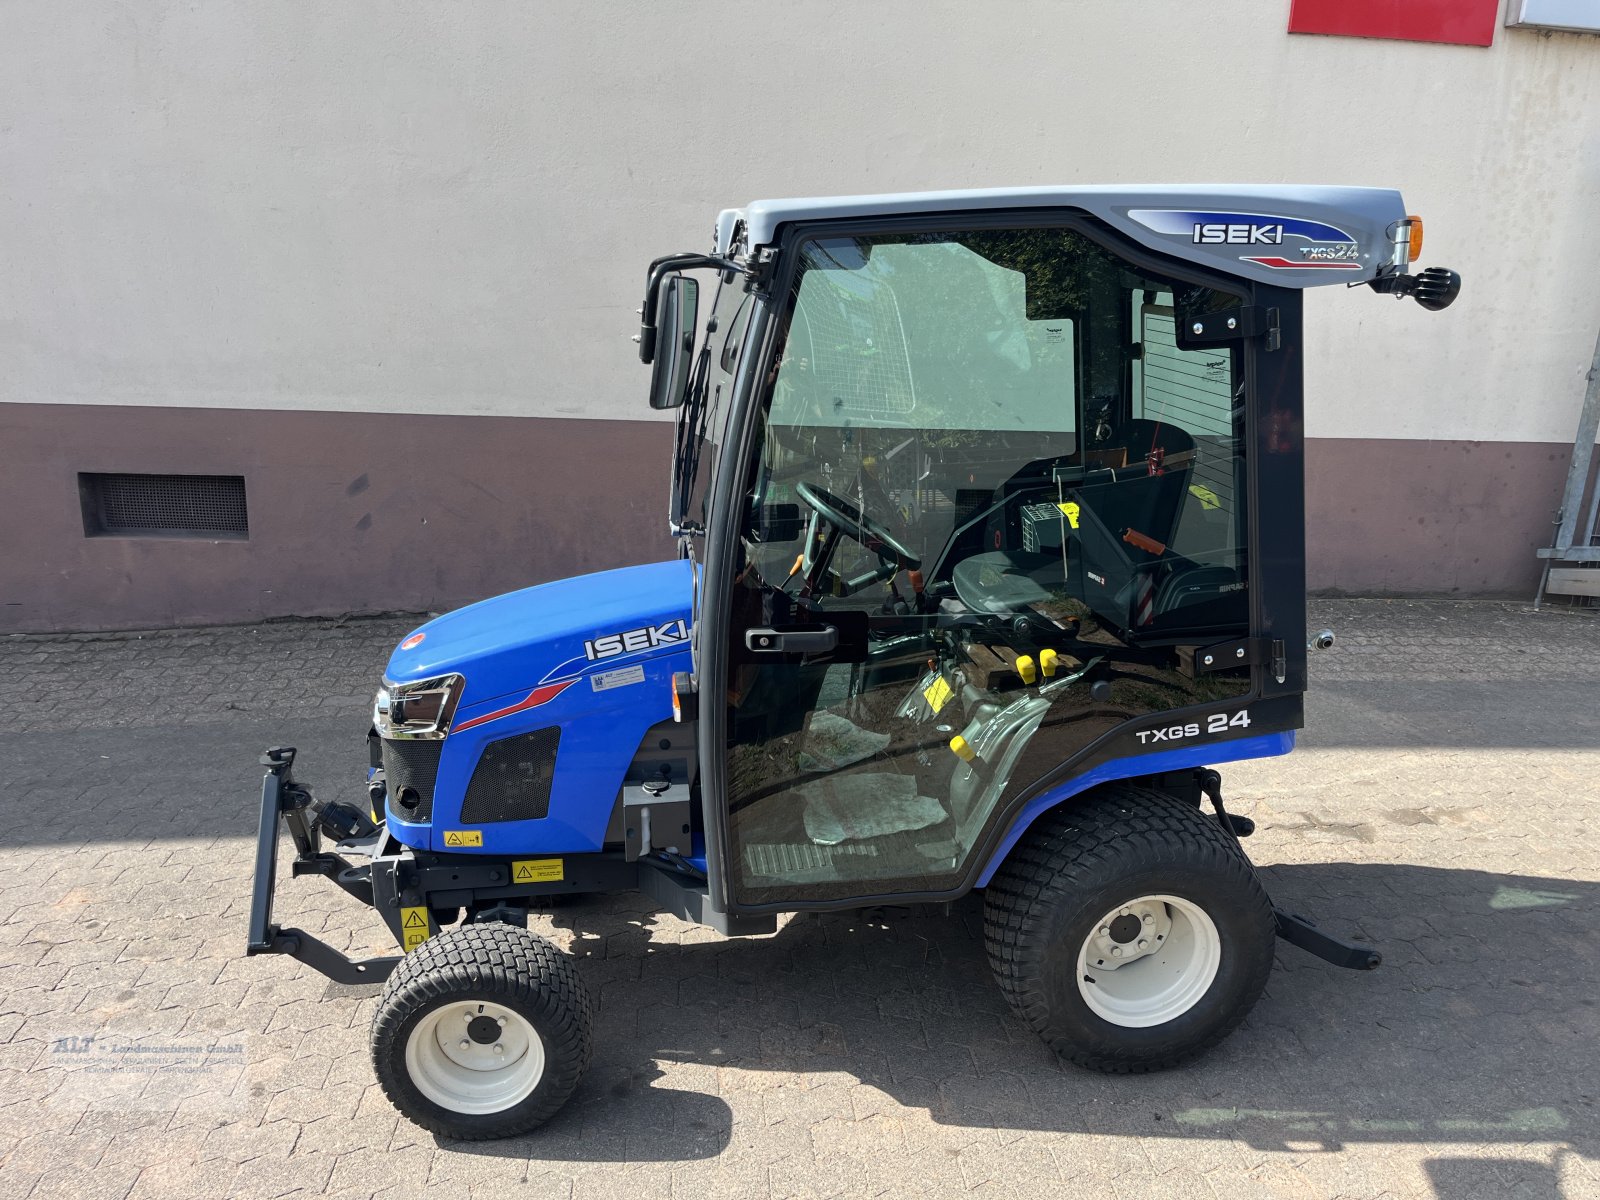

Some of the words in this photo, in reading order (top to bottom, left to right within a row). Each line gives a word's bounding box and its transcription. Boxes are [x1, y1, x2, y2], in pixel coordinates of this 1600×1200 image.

[1193, 223, 1284, 245] ISEKI
[584, 619, 689, 660] ISEKI
[1136, 723, 1200, 744] TXGS
[1207, 710, 1251, 733] 24
